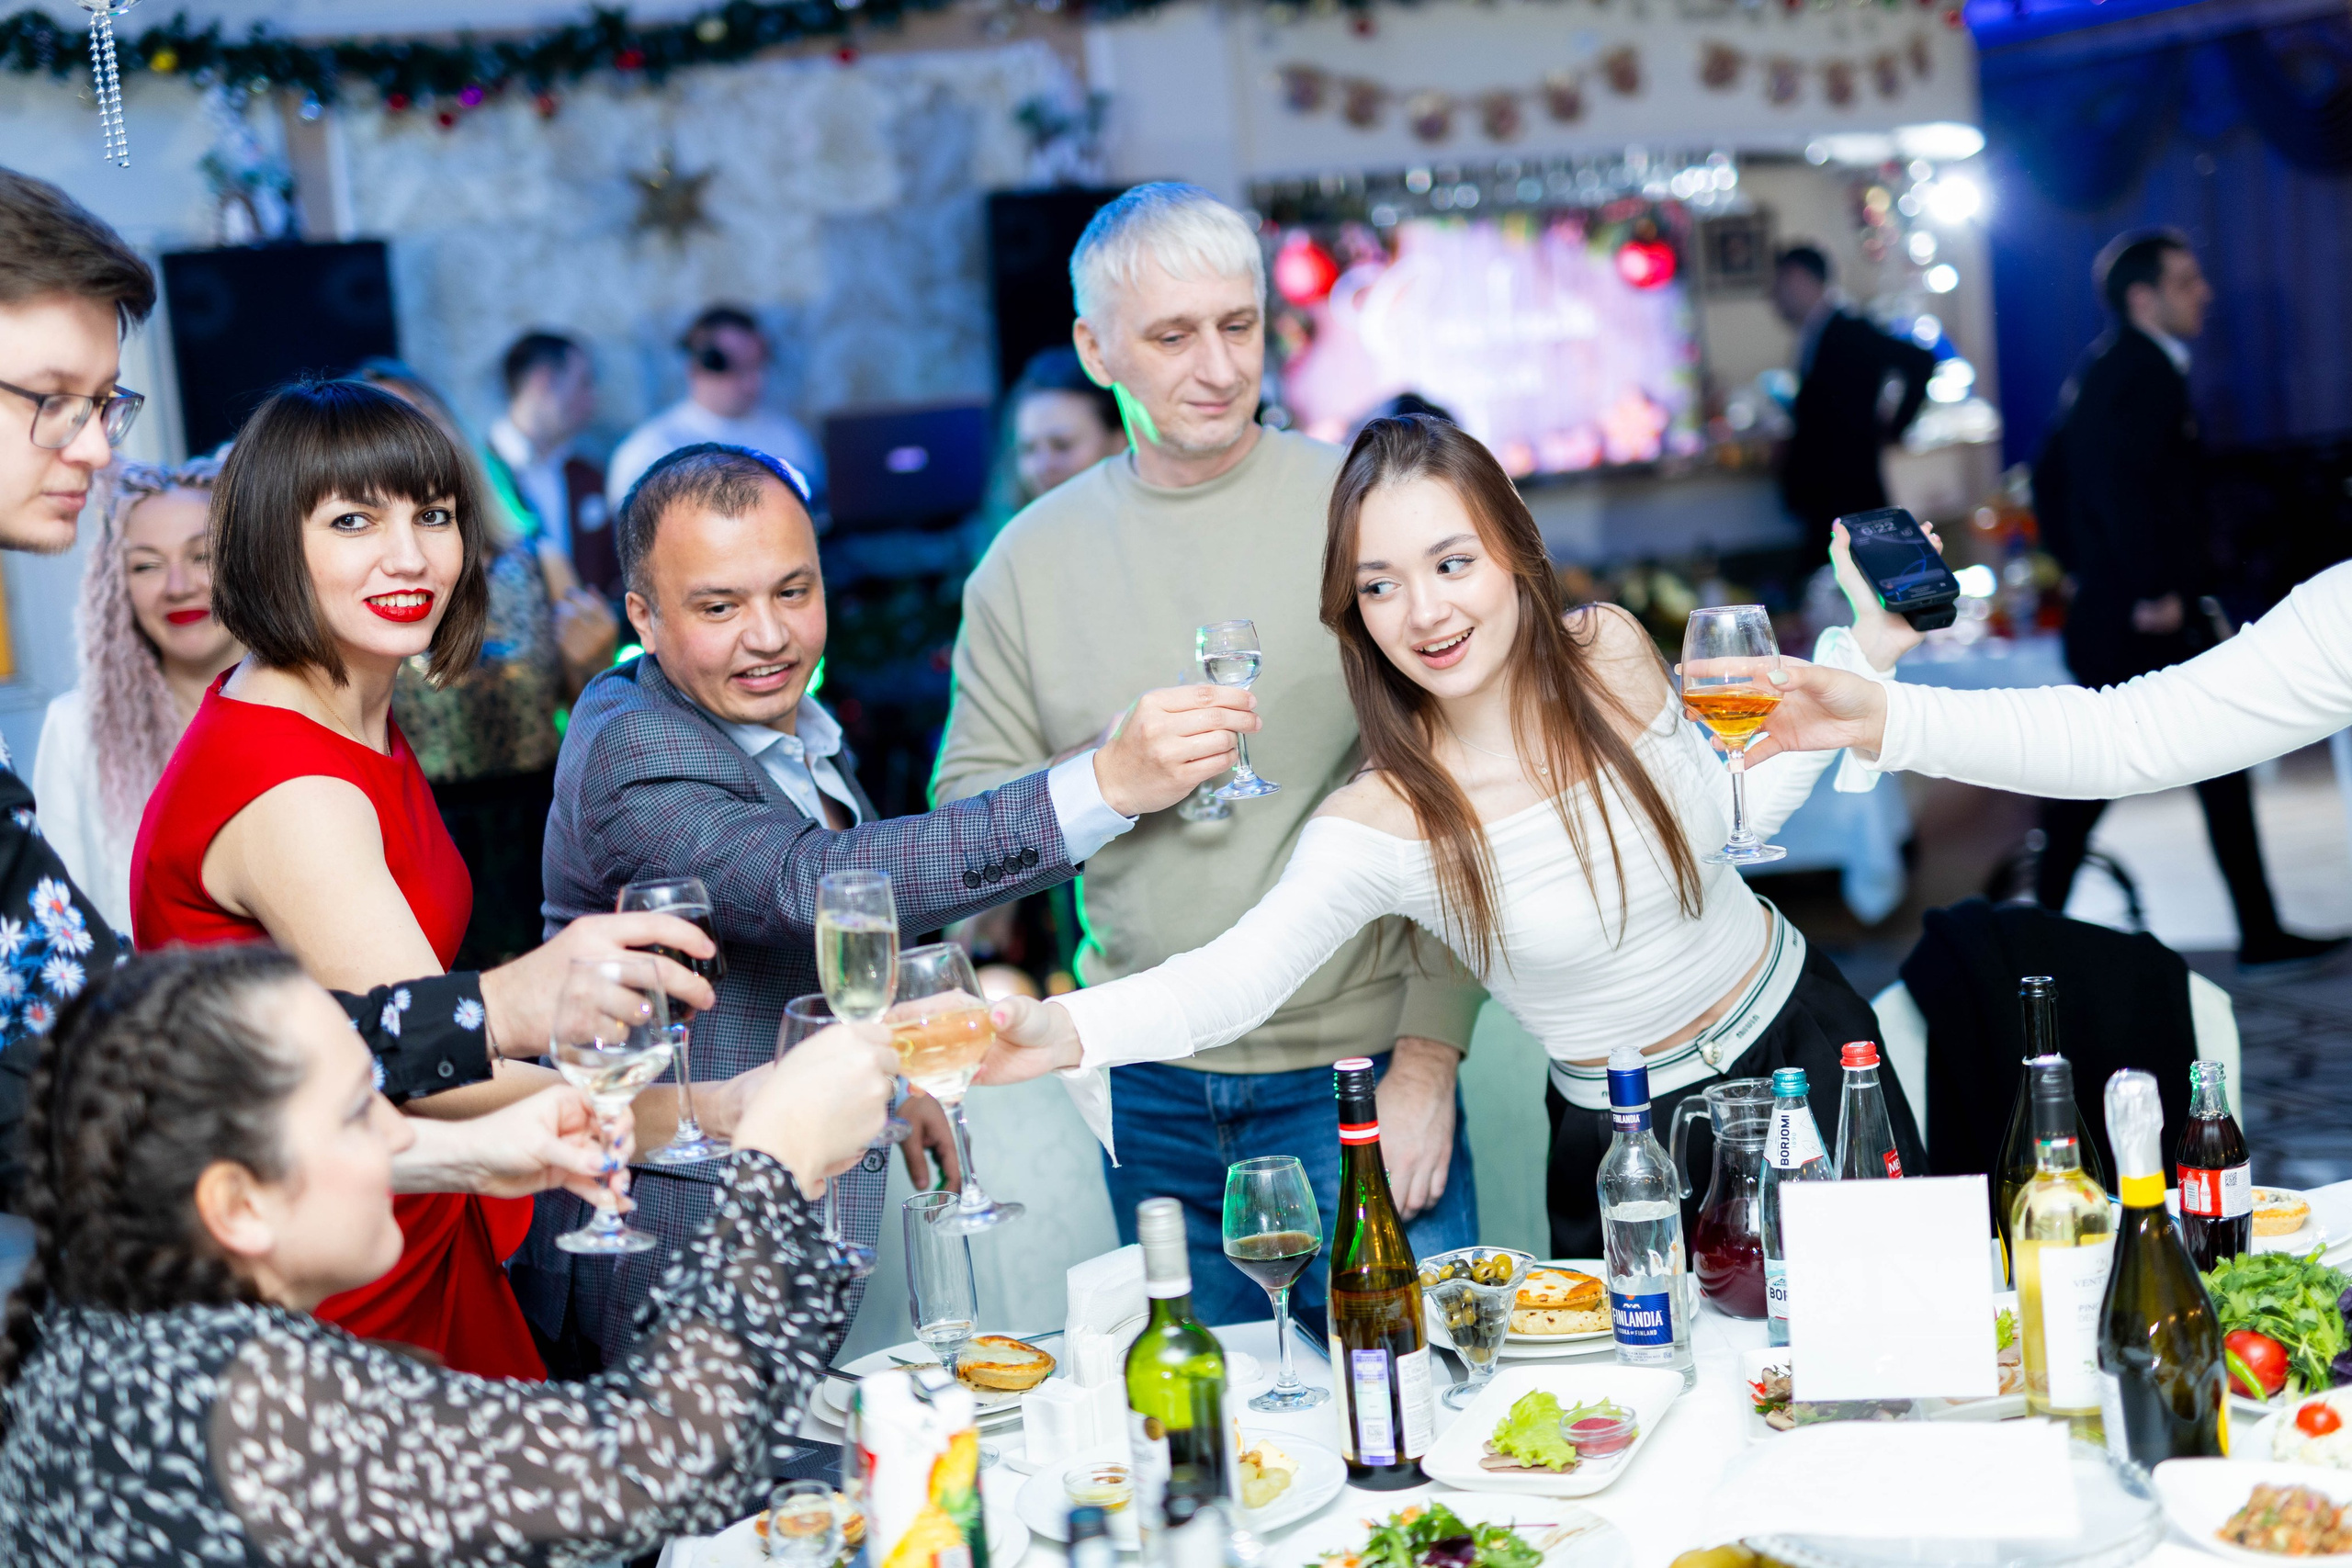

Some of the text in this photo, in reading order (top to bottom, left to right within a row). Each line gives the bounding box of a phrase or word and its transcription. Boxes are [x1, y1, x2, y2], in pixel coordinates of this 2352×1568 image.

[1612, 1113, 1641, 1123] FINLANDIA
[1781, 1115, 1790, 1166] BORJOMI
[2073, 1275, 2106, 1287] VENT
[1612, 1307, 1663, 1327] FINLANDIA
